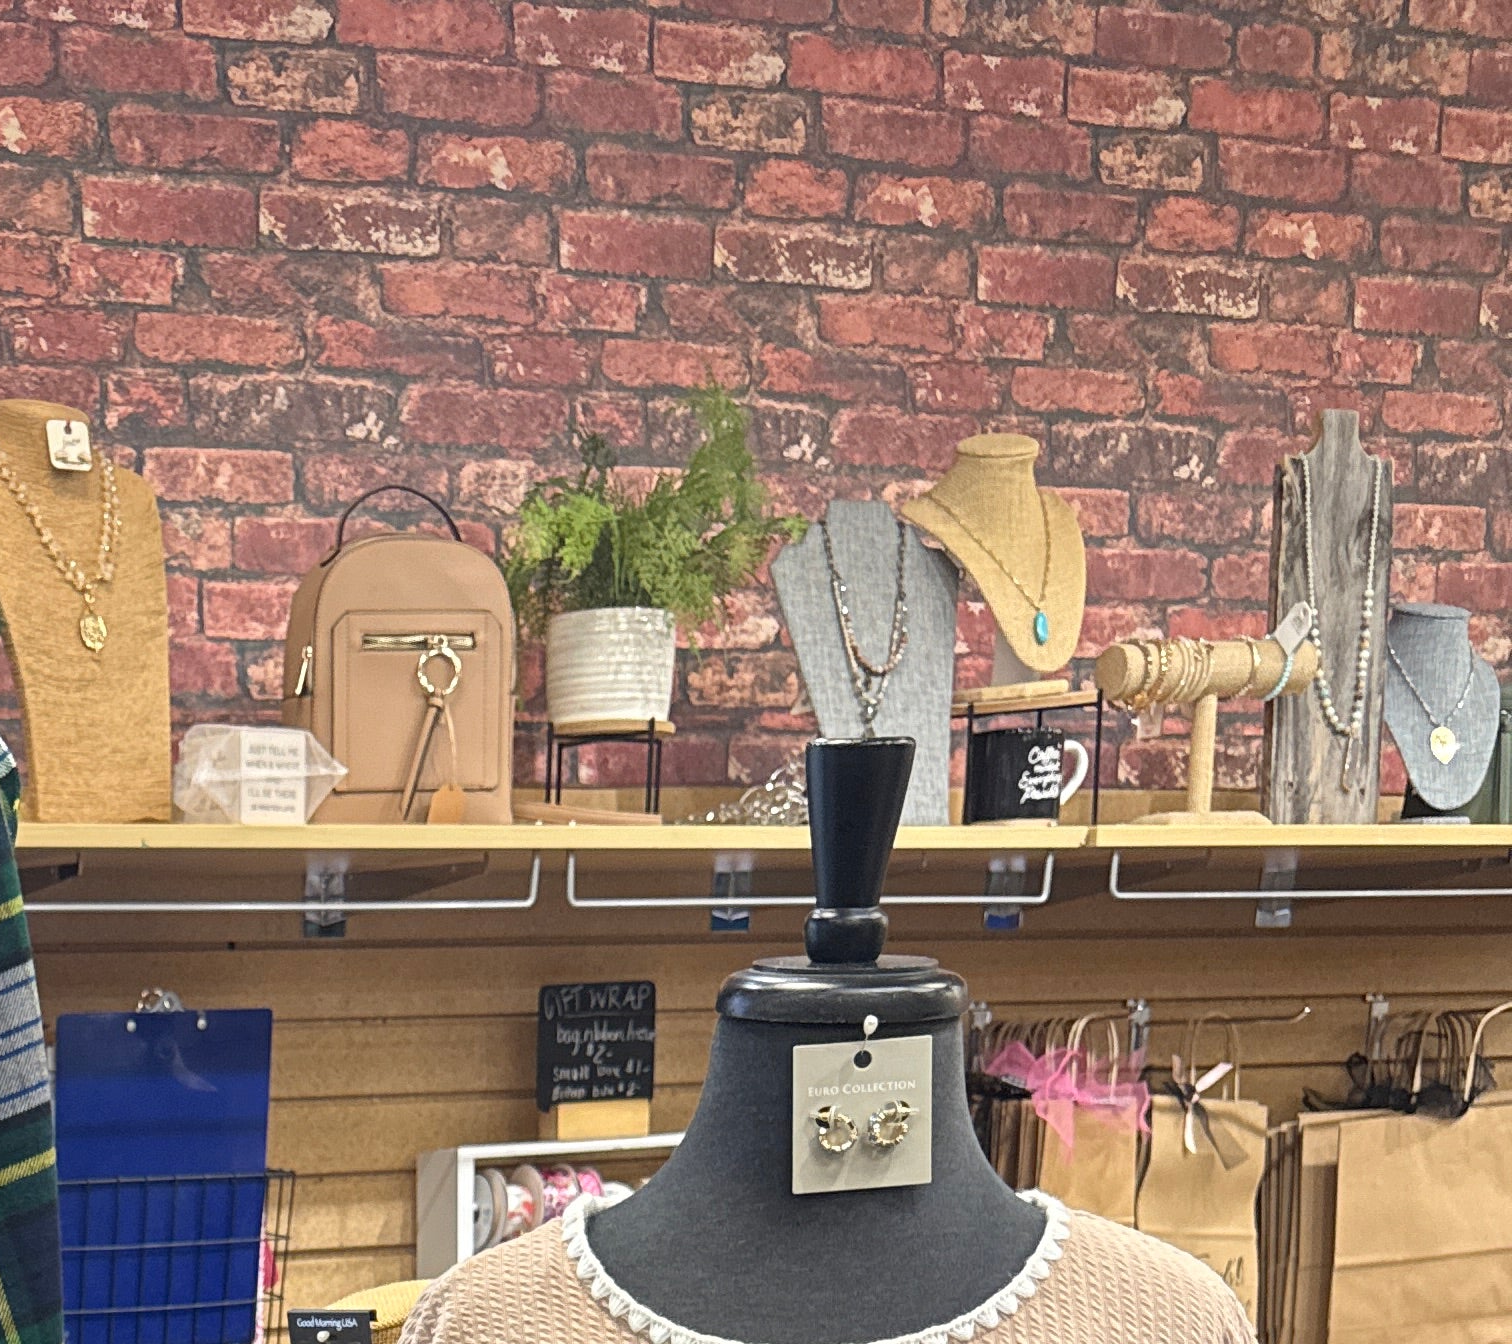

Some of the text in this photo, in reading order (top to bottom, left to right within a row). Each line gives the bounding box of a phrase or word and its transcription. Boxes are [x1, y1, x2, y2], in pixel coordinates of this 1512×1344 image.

[589, 983, 652, 1011] WRAP
[807, 1086, 840, 1097] EURO
[296, 1316, 315, 1328] Good
[341, 1318, 359, 1328] USA
